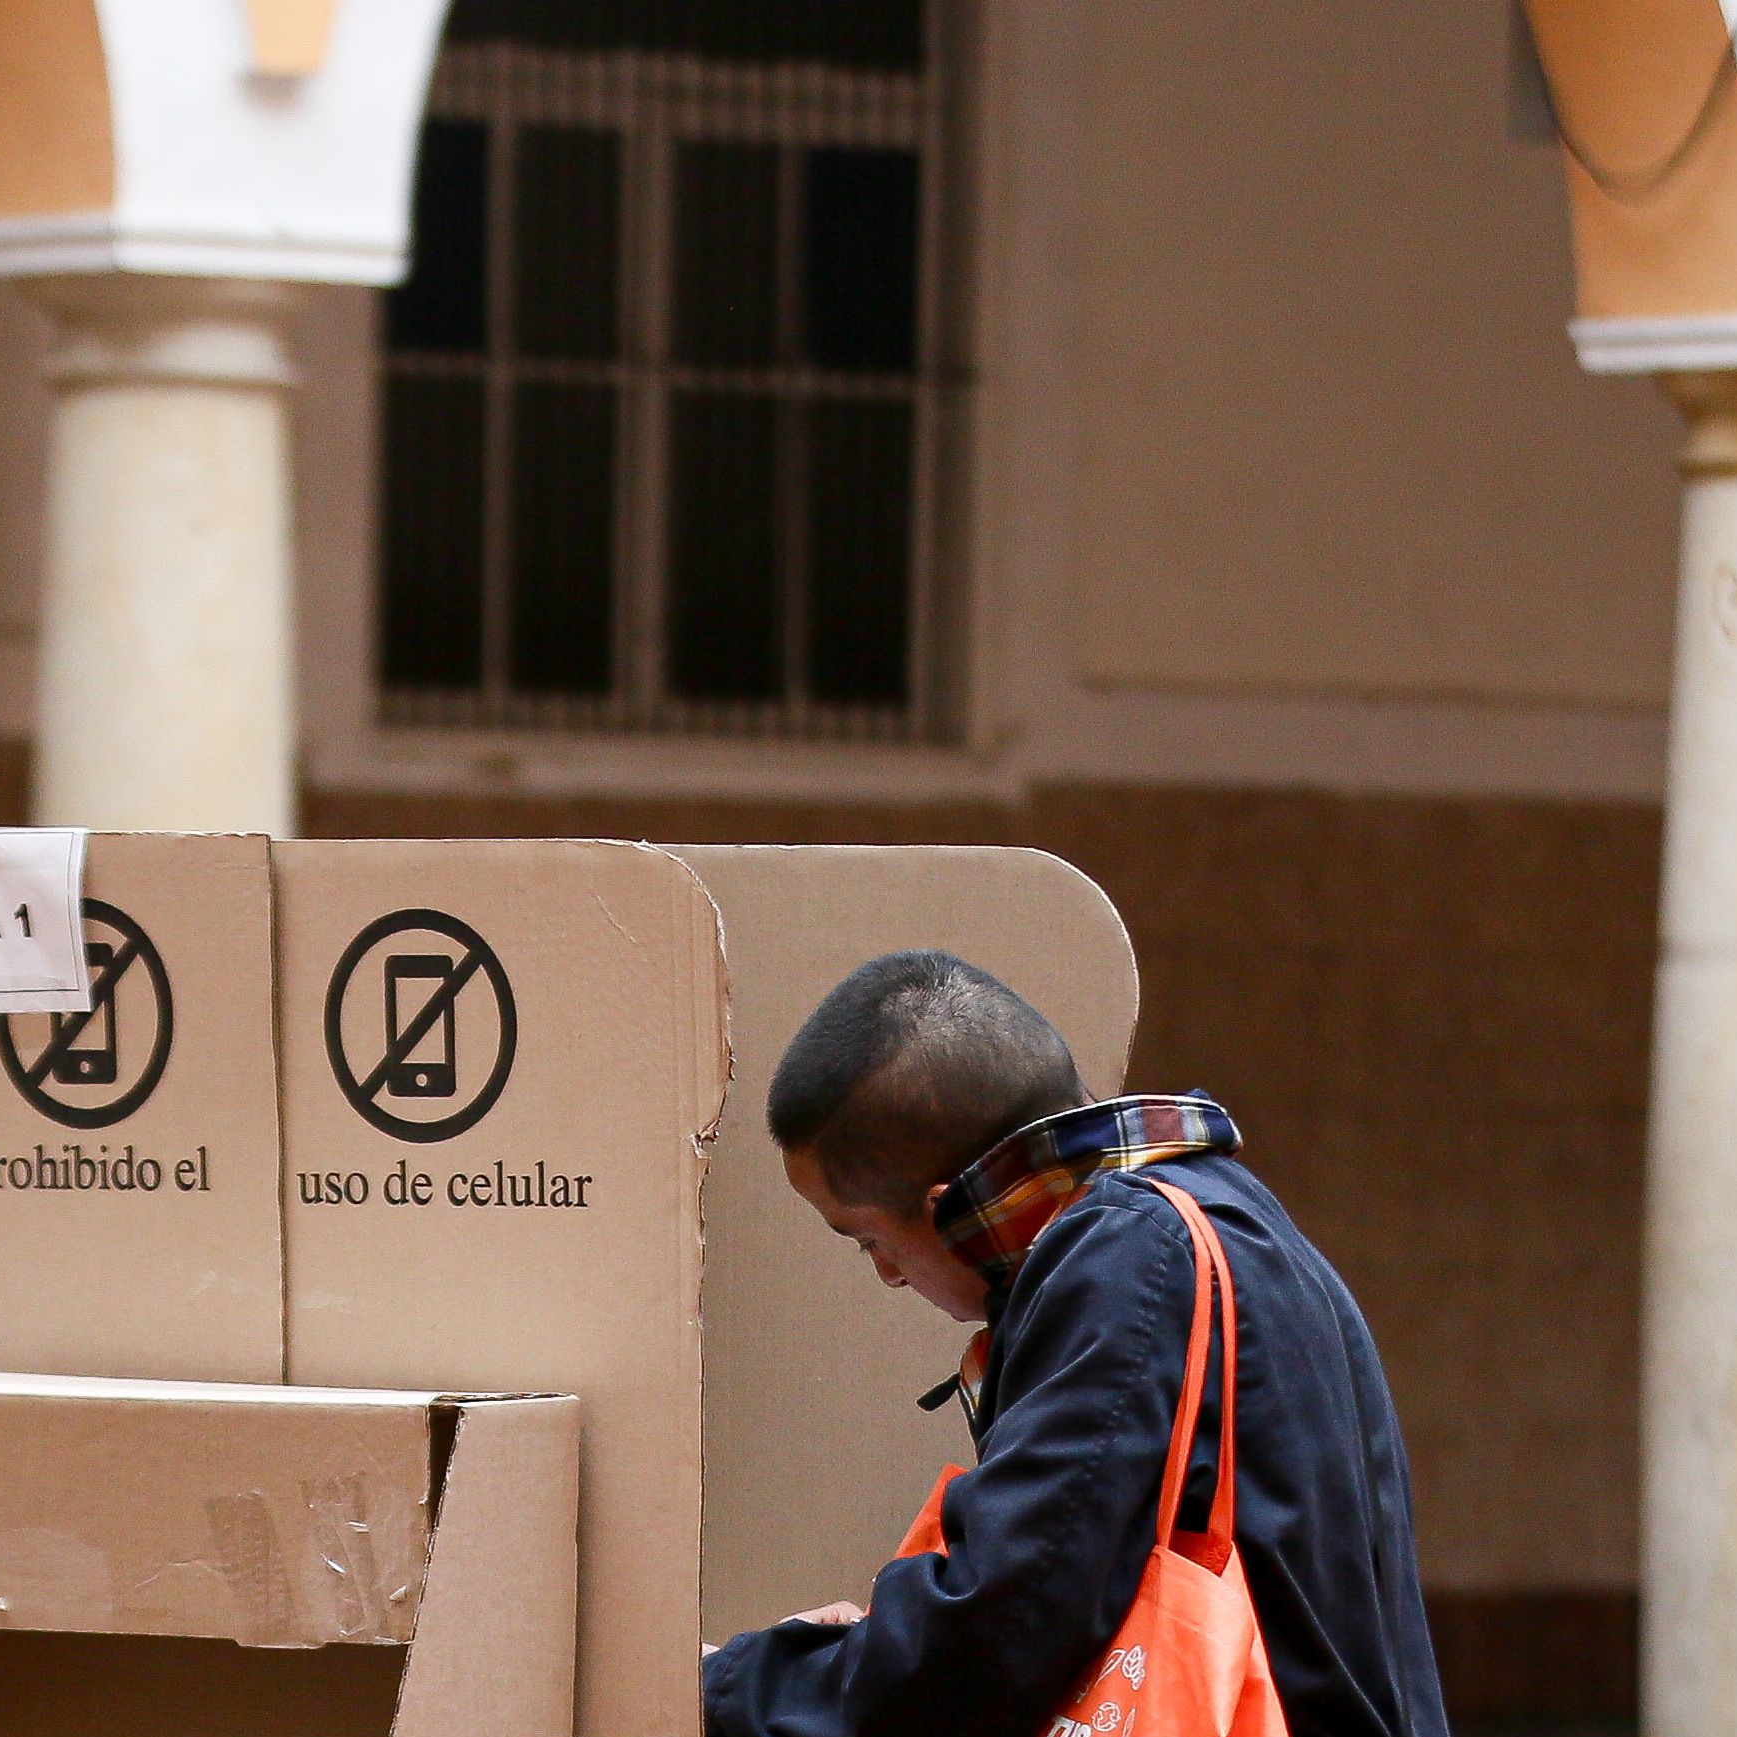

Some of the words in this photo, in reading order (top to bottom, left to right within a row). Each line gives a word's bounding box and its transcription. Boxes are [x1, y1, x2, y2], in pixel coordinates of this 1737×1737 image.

[13, 902, 31, 938] 1
[174, 1146, 210, 1192] el
[297, 1169, 369, 1206] uso
[383, 1160, 433, 1206] de
[446, 1161, 593, 1208] celular
